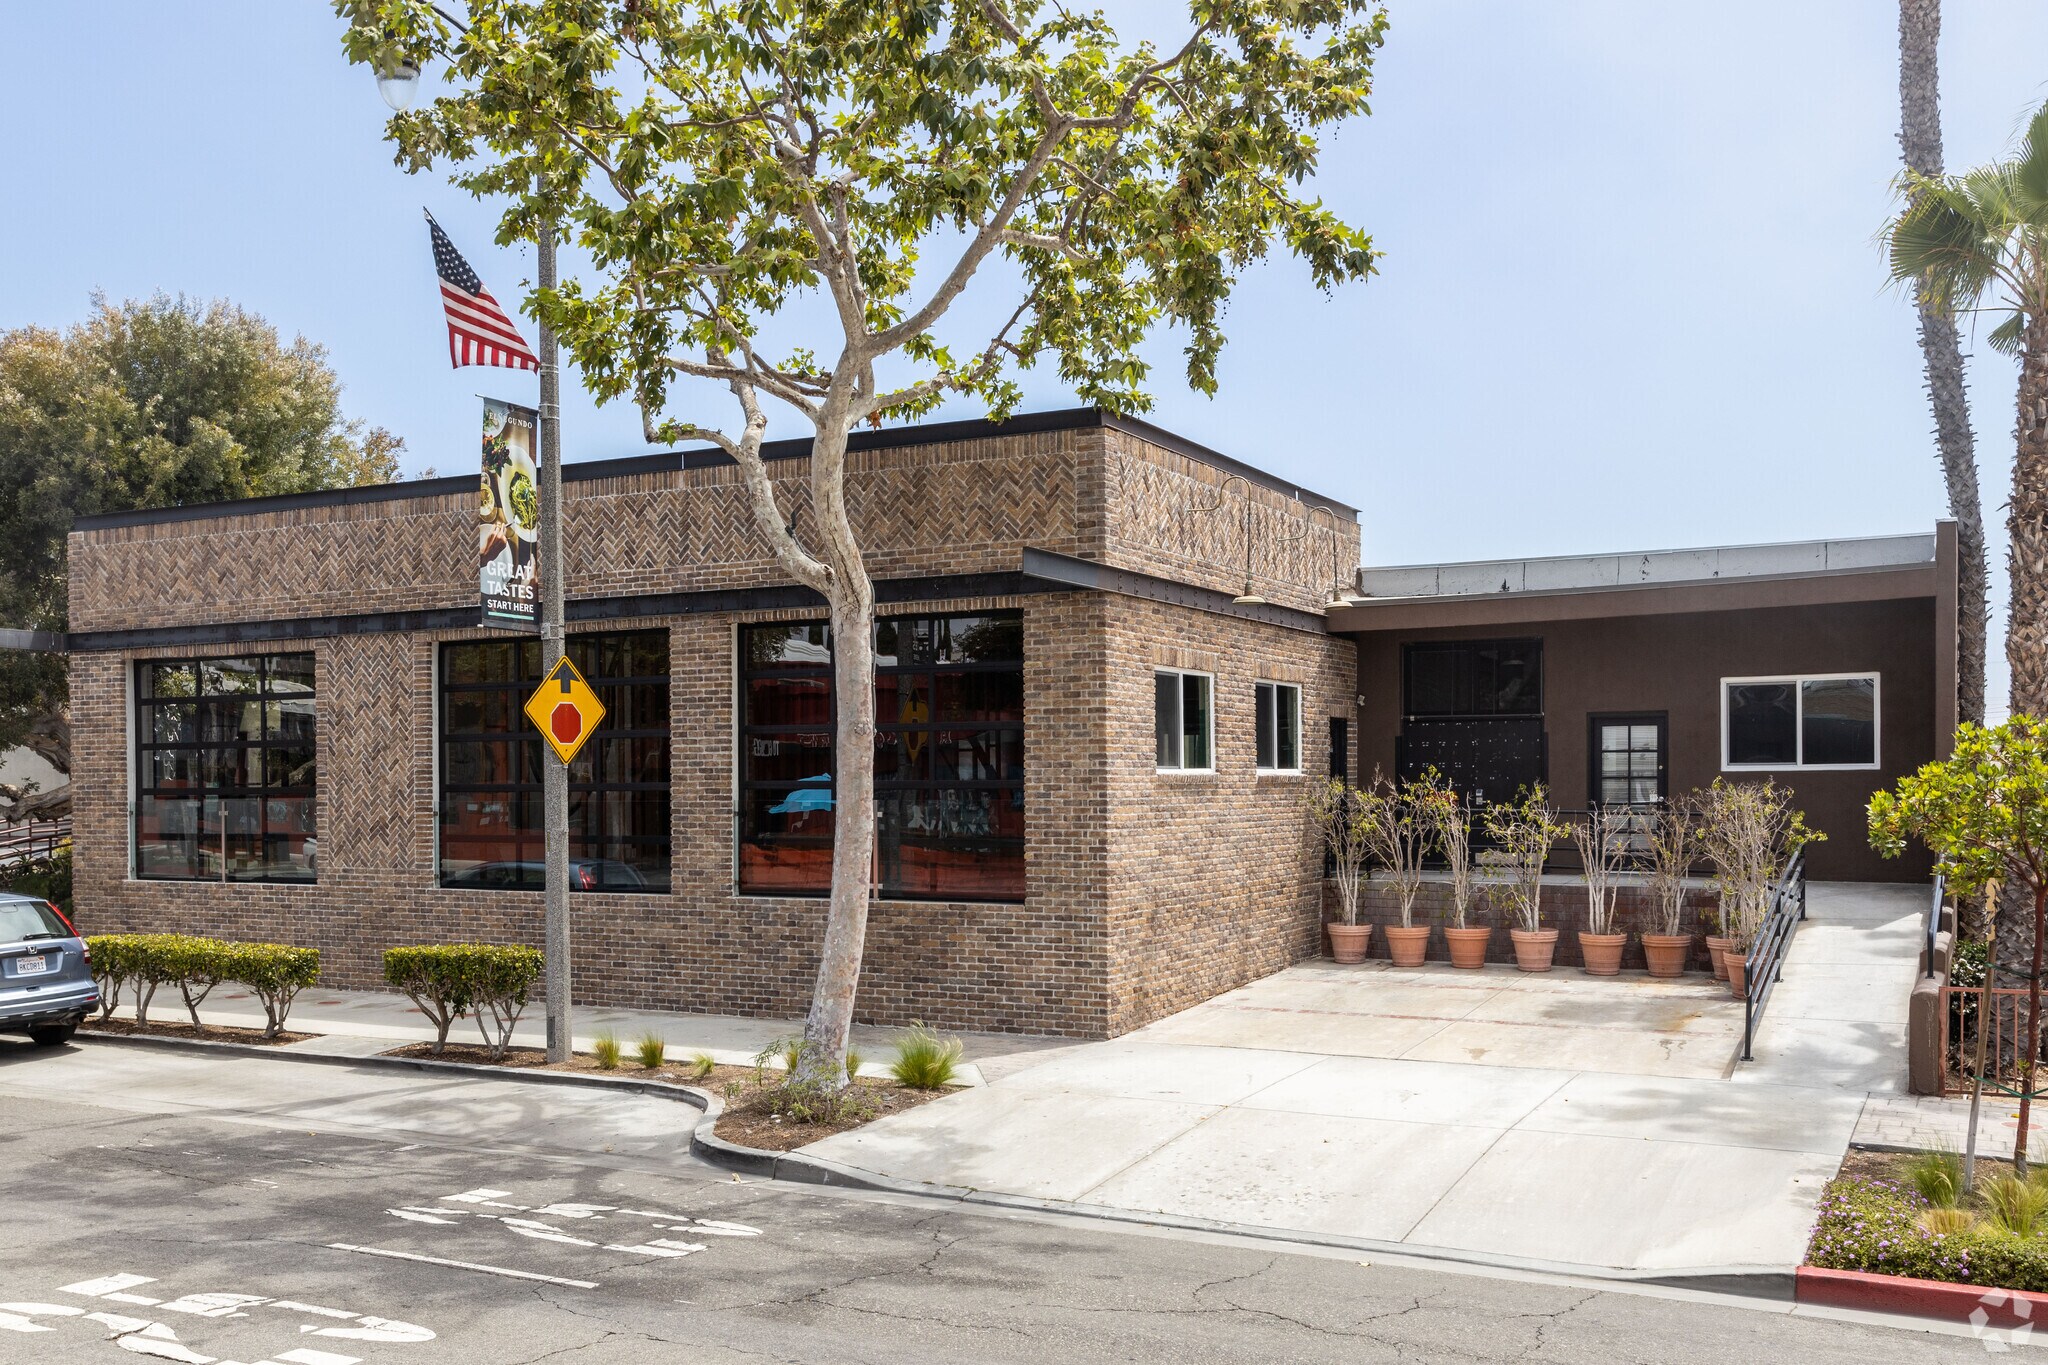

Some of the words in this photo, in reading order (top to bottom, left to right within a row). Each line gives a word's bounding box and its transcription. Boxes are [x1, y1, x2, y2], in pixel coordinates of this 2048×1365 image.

[486, 560, 531, 581] GREAT
[487, 580, 534, 600] TASTES
[487, 599, 511, 610] START
[513, 602, 534, 613] HERE
